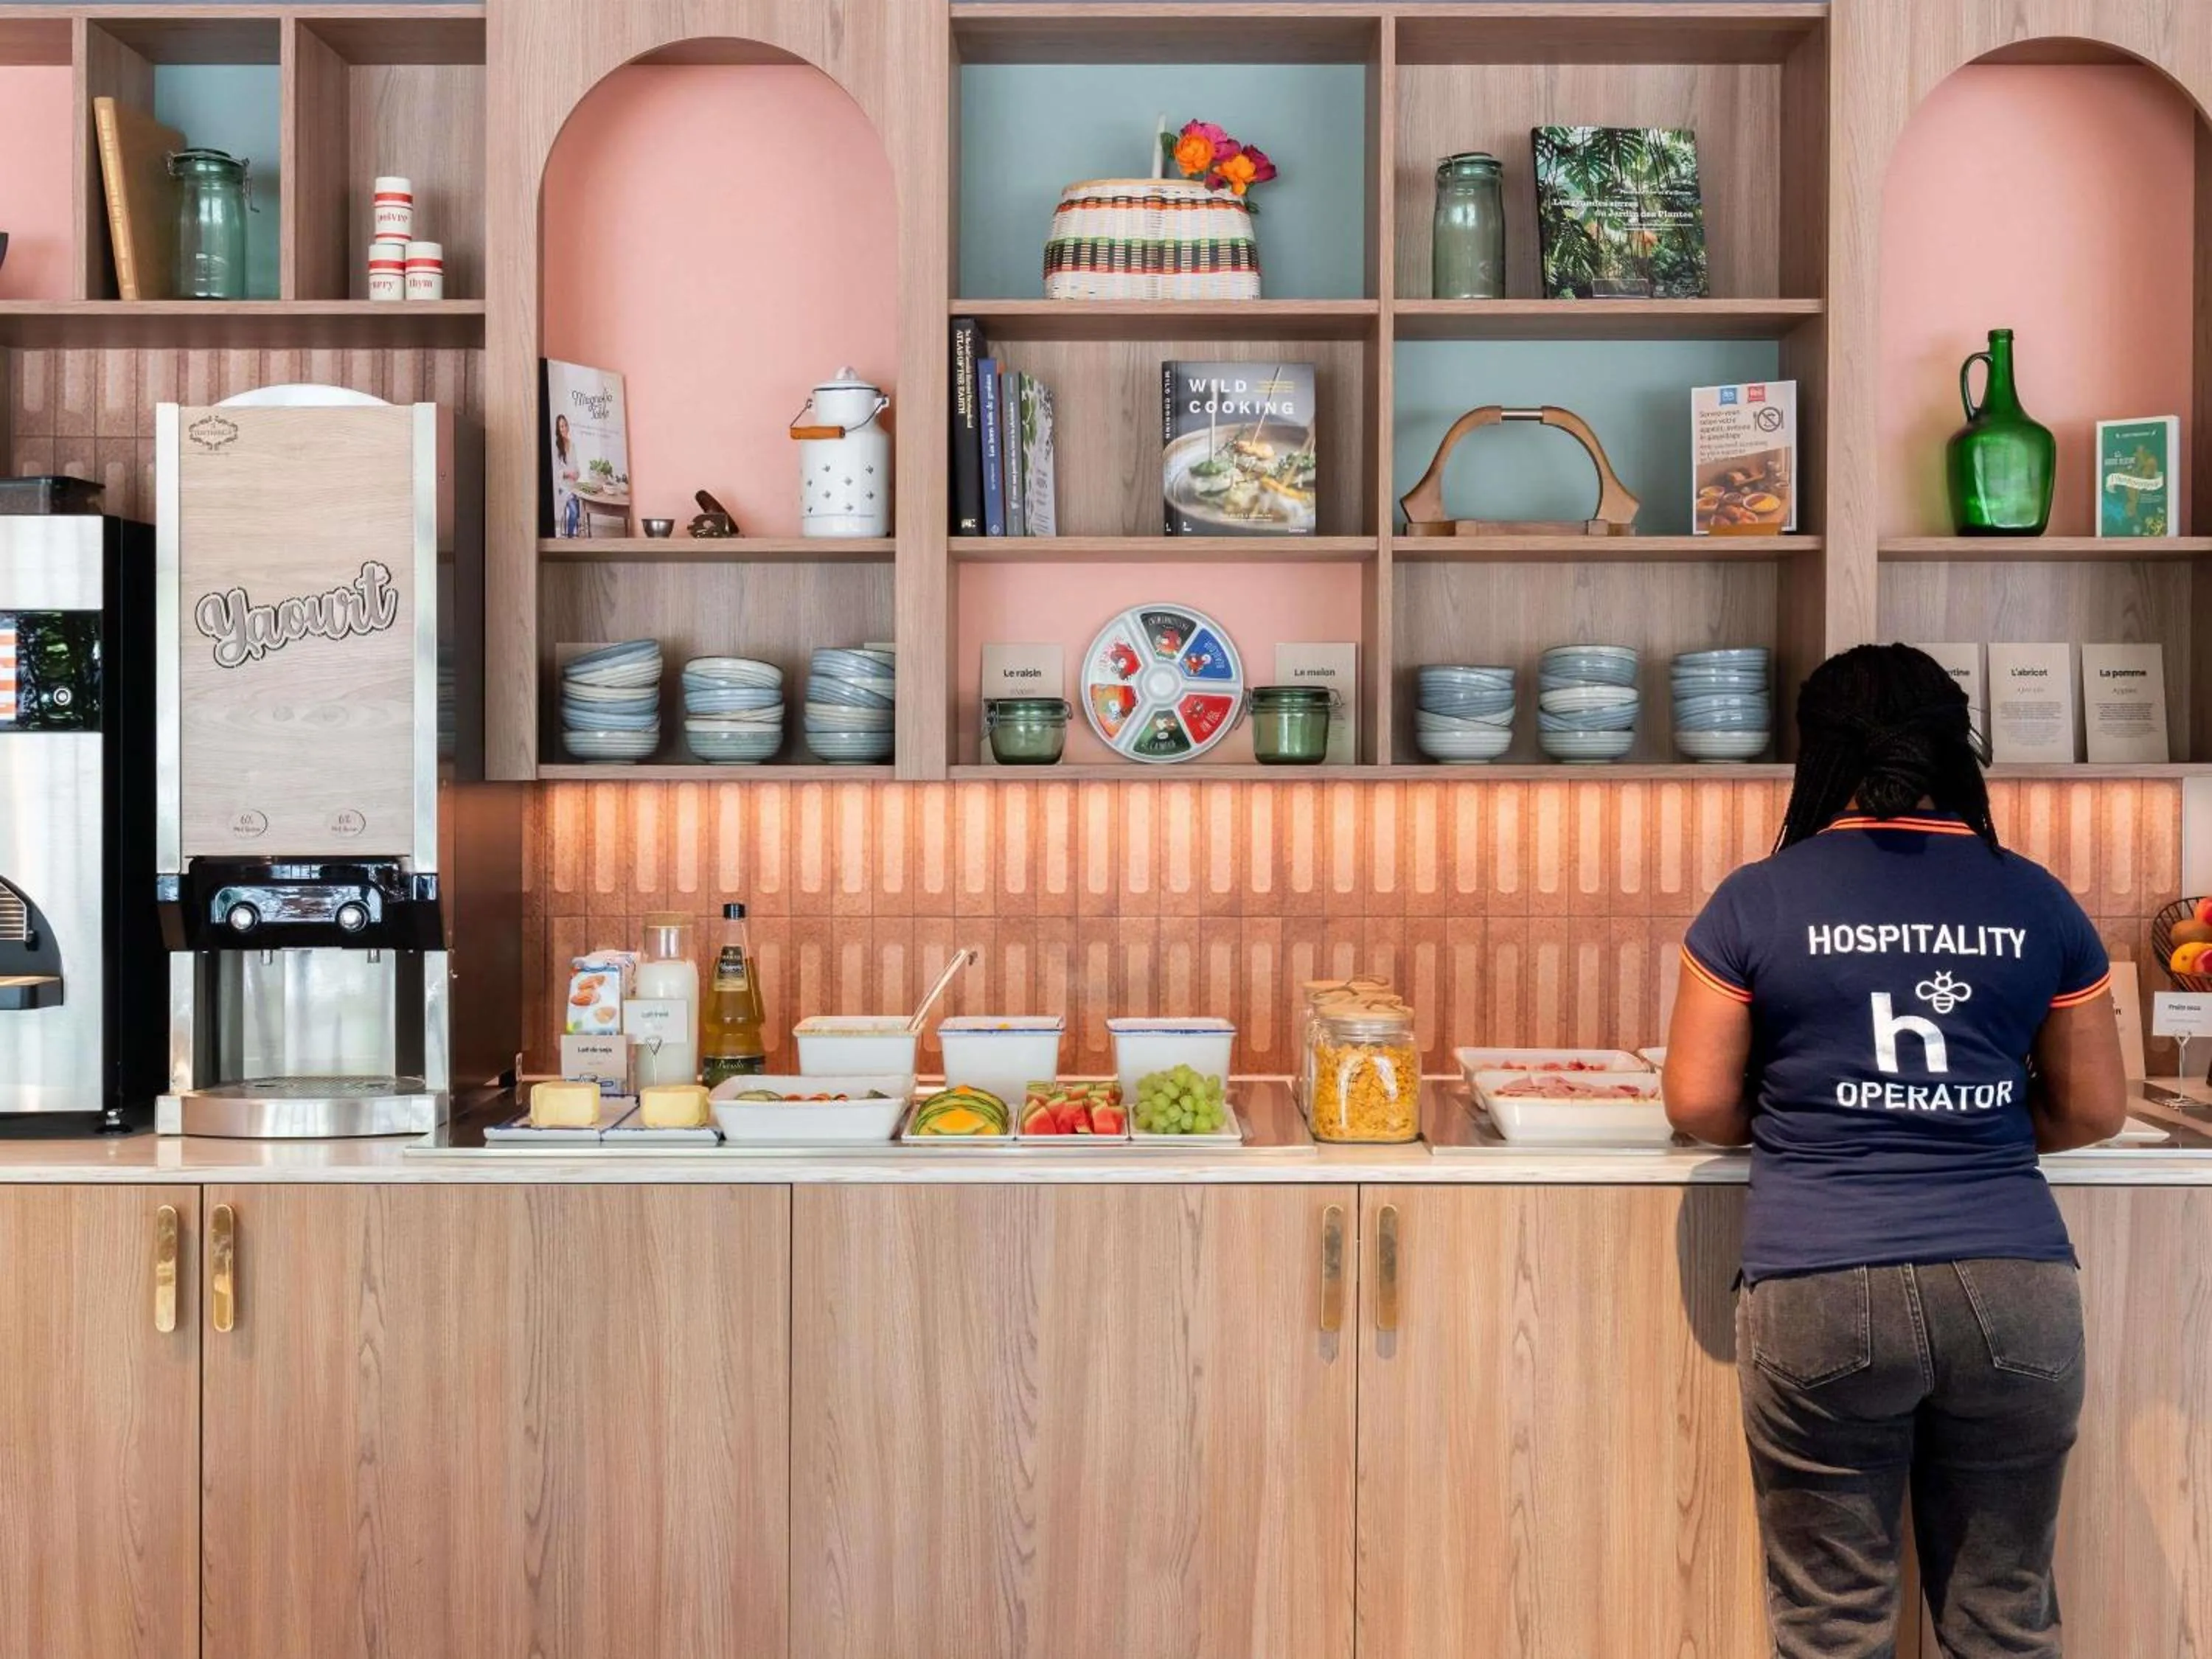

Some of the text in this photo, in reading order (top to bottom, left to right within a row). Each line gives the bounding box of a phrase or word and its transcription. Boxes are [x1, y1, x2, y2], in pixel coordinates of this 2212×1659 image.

[1189, 378, 1247, 393] WILD
[1189, 400, 1295, 415] COOKING
[195, 561, 398, 668] Yaourt
[1004, 668, 1042, 678] Le raisin
[1294, 667, 1335, 676] Le melon
[2011, 668, 2048, 676] L'abricot
[2112, 669, 2146, 678] pomme
[1808, 924, 2026, 959] HOSPITALITY
[1870, 992, 1948, 1073] h
[1836, 1081, 2014, 1110] OPERATOR
